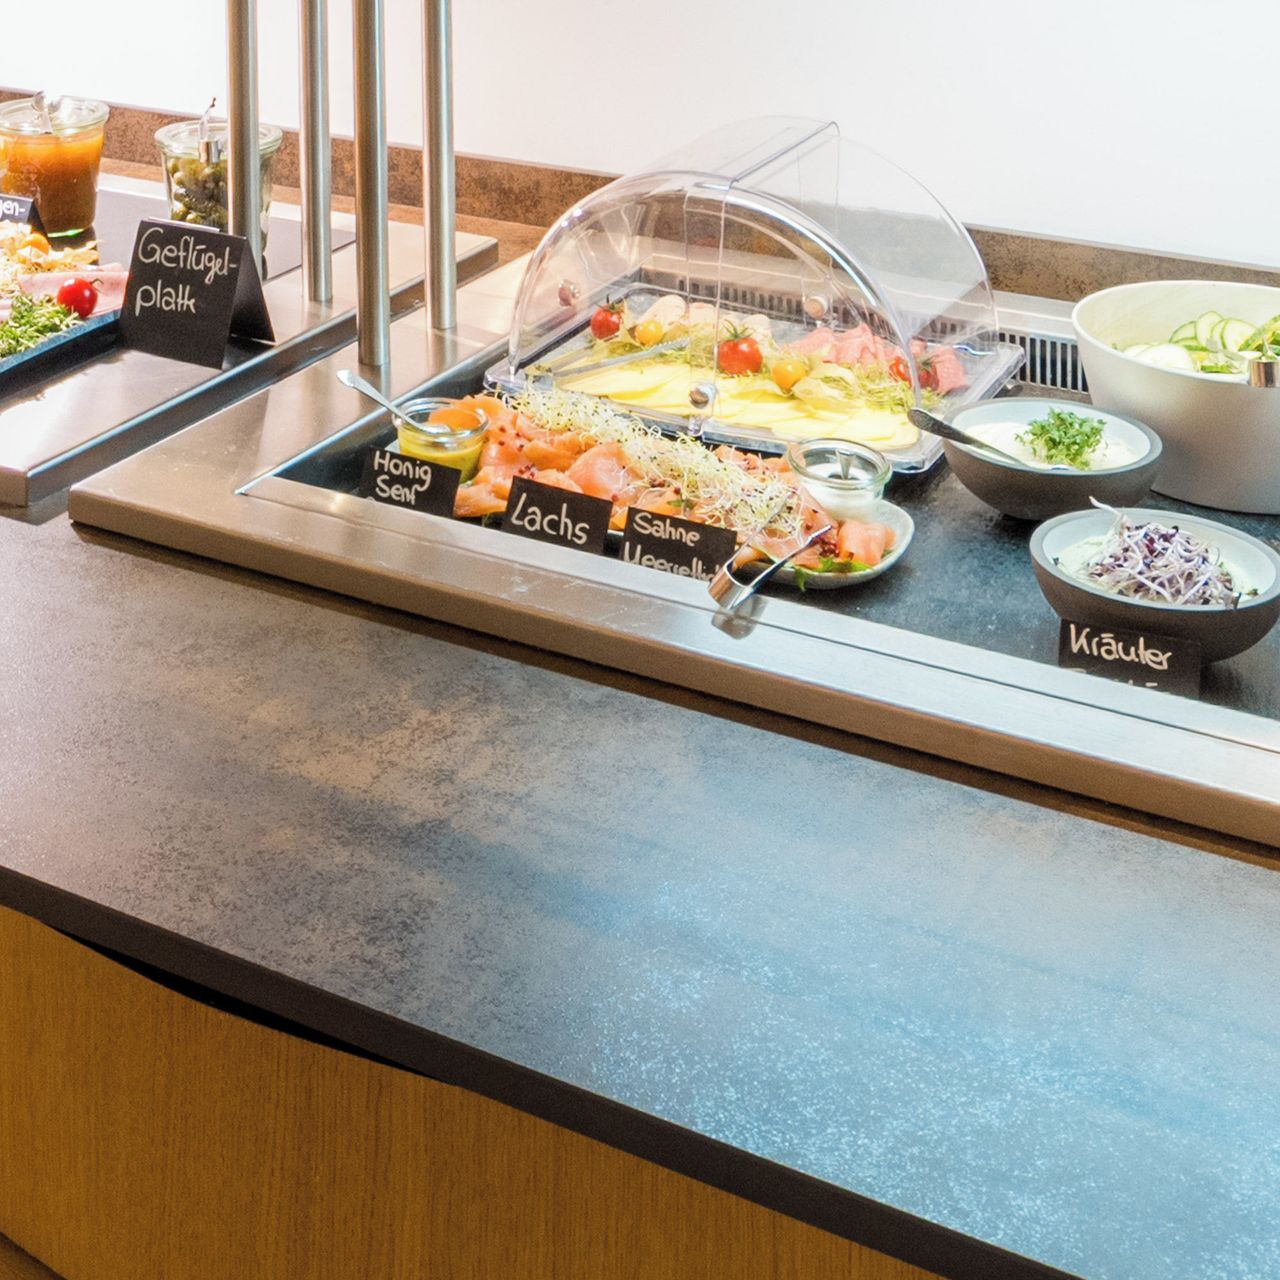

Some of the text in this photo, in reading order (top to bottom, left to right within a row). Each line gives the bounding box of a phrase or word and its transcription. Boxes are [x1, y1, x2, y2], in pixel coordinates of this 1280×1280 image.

[138, 226, 238, 286] Geflügel-
[373, 450, 433, 492] Honig
[510, 492, 591, 546] Lachs
[632, 511, 702, 548] Sahne
[1070, 623, 1173, 670] Kräuter
